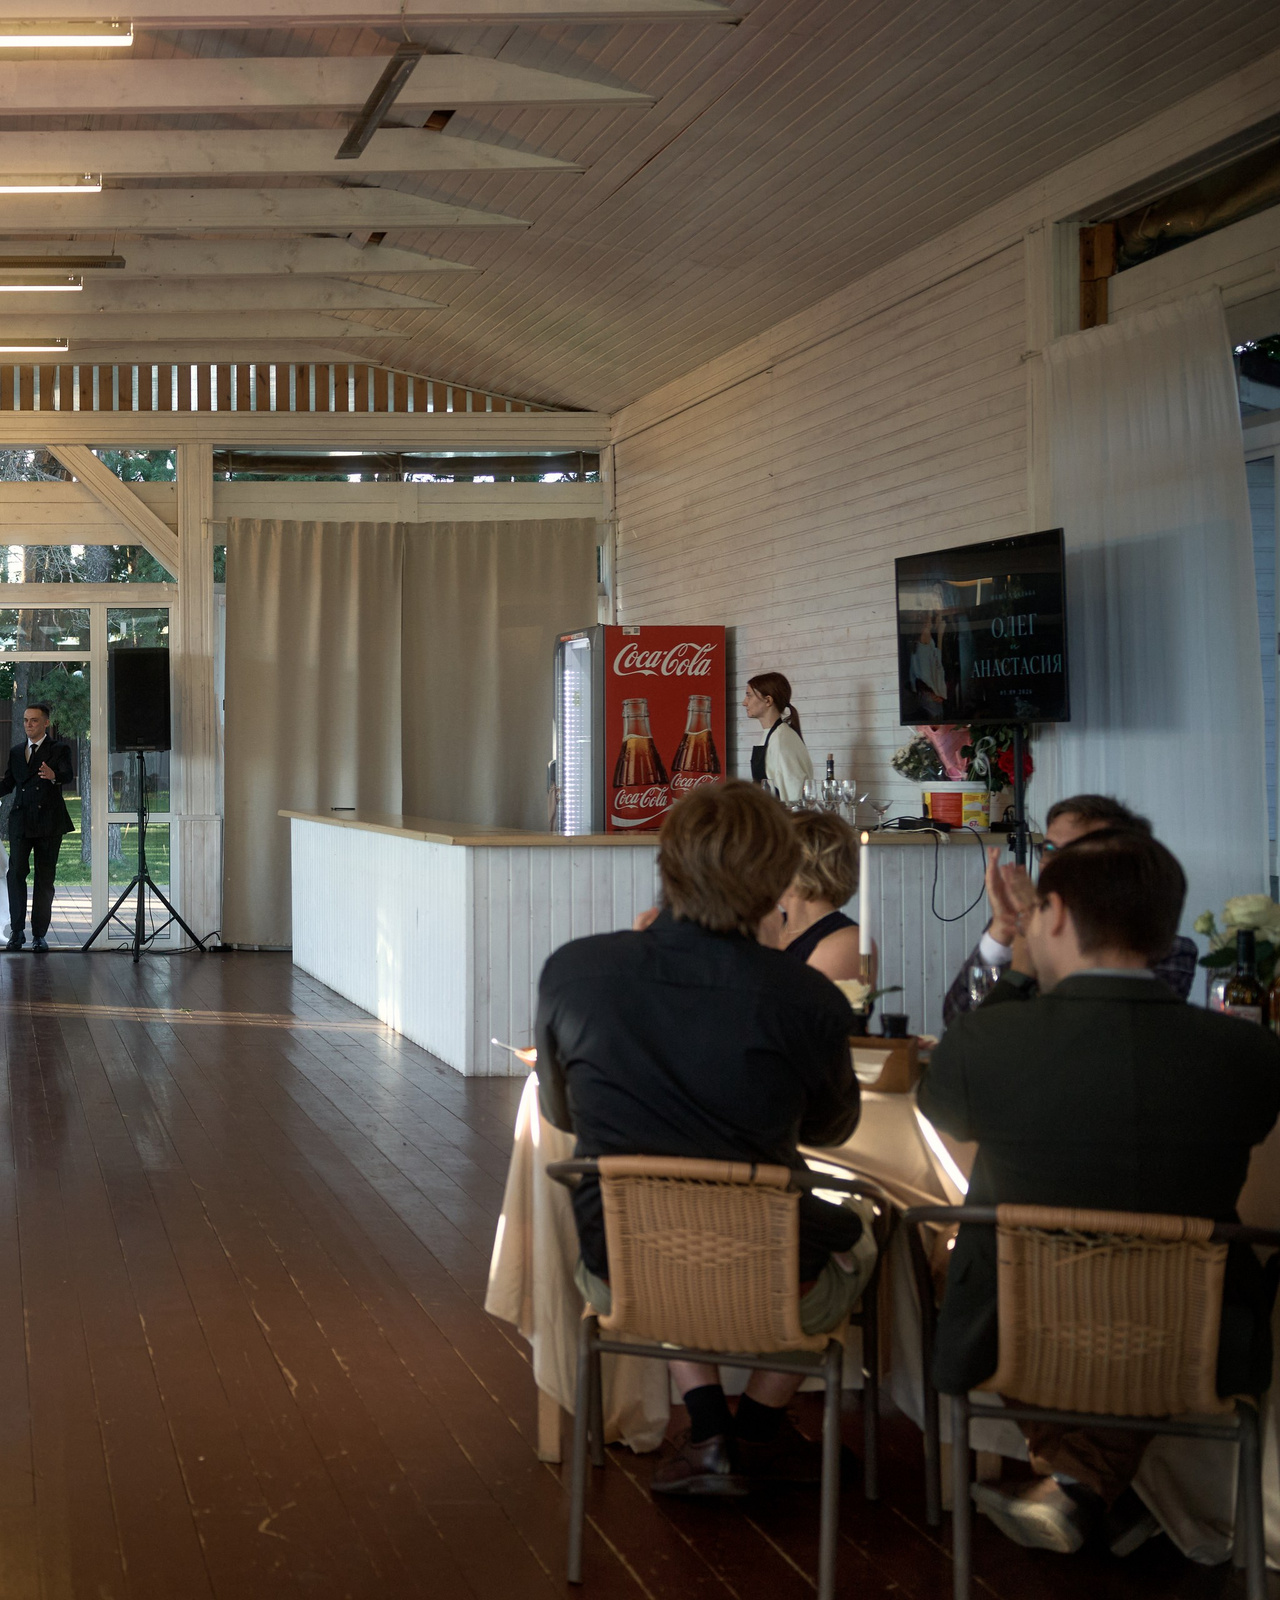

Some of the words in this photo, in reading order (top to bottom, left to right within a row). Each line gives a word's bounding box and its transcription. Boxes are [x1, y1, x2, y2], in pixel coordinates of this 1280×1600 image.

[991, 613, 1038, 639] ОЛЕГ
[613, 642, 718, 677] Coca-Cola
[971, 653, 1063, 679] АНАСТАСИЯ
[614, 786, 669, 810] Coca-Cola
